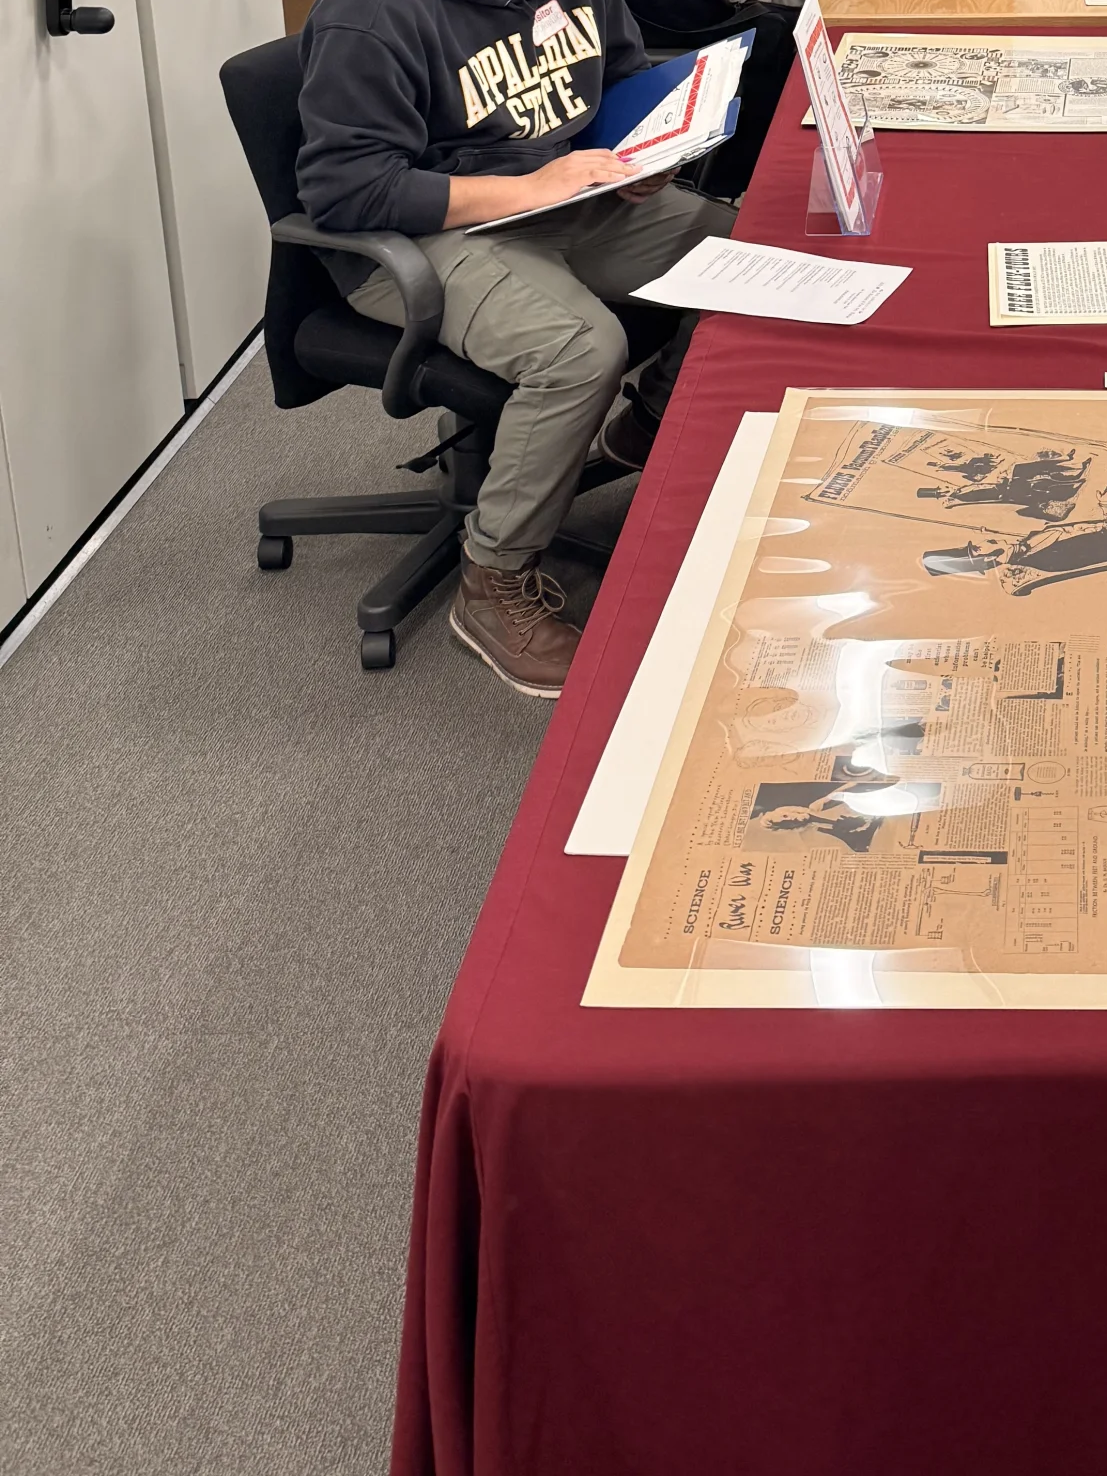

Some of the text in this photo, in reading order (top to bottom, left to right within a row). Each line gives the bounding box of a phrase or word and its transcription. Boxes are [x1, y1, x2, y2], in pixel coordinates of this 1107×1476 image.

[1008, 293, 1034, 313] FREE
[818, 471, 856, 500] FLUXUS
[683, 870, 711, 934] SCIENCE
[769, 869, 796, 935] SCIENCE
